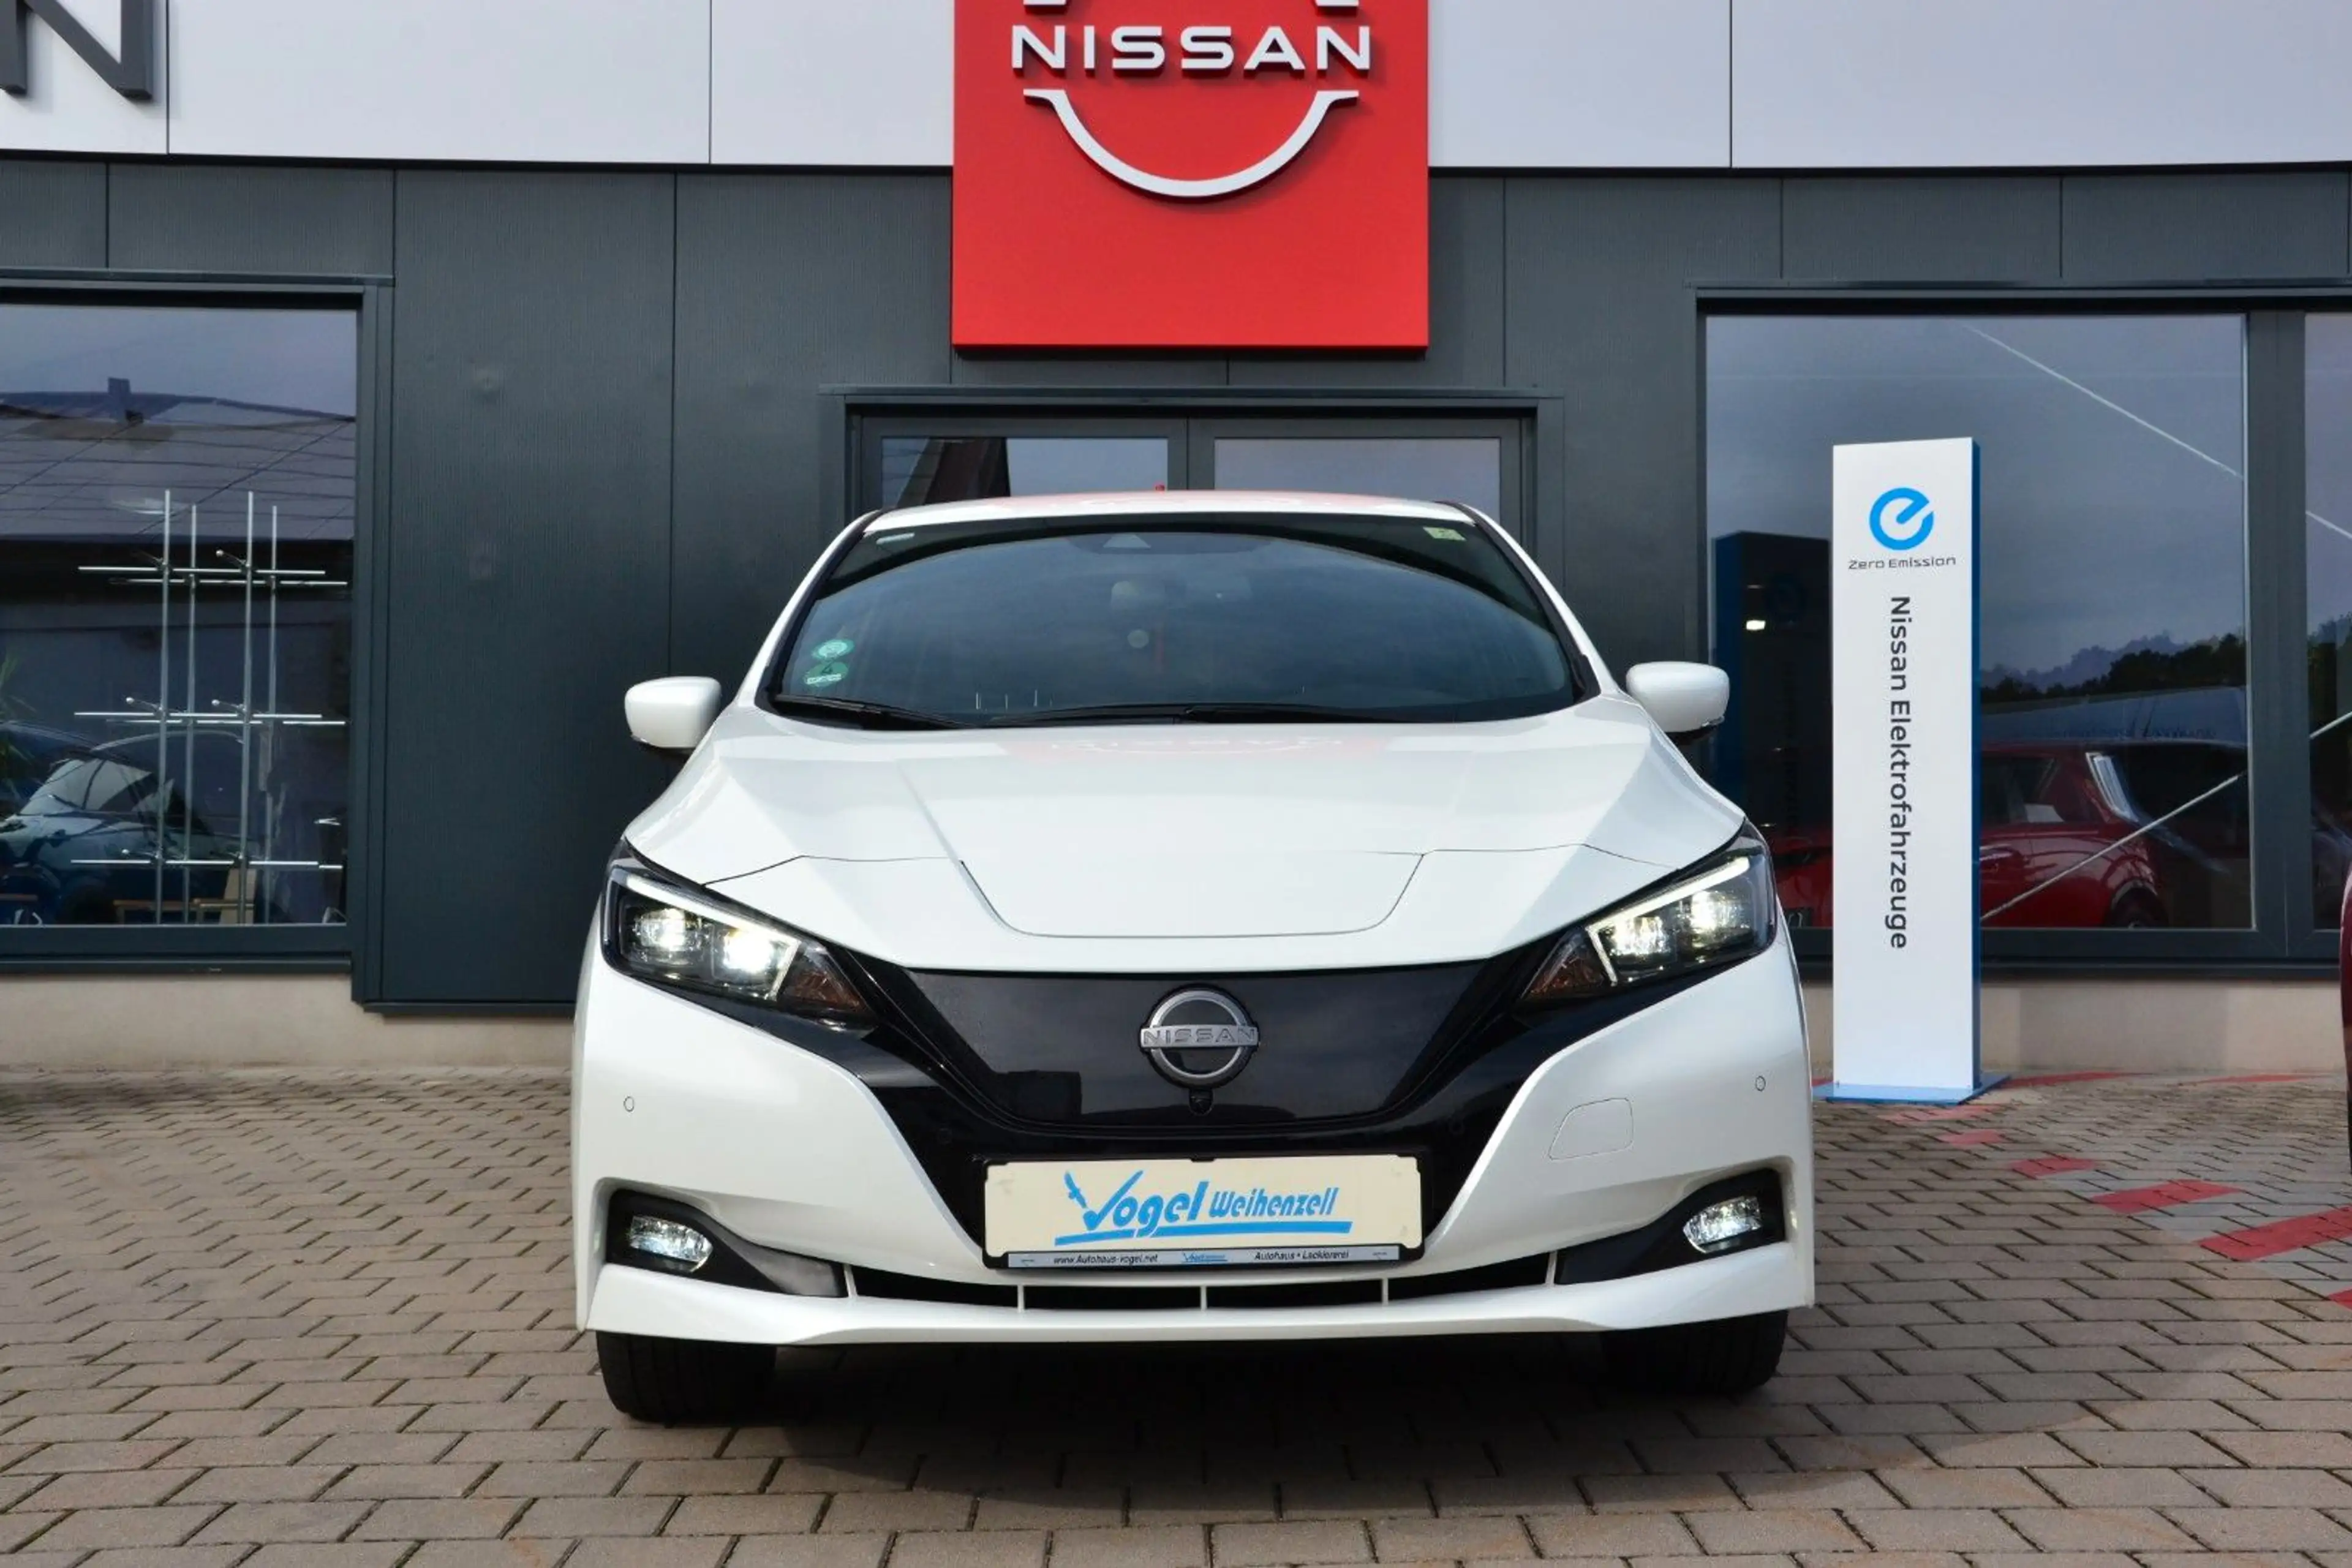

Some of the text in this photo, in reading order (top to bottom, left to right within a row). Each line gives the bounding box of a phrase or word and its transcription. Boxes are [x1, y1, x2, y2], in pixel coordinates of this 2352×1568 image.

[1012, 25, 1370, 71] NISSAN
[1848, 556, 1956, 570] Zero Emission
[1885, 596, 1912, 949] Nissan Elektrofahrzeuge
[1144, 1028, 1255, 1044] NISSAN
[1064, 1170, 1340, 1237] Vogel Weihenzell
[1254, 1251, 1294, 1261] Autohaus
